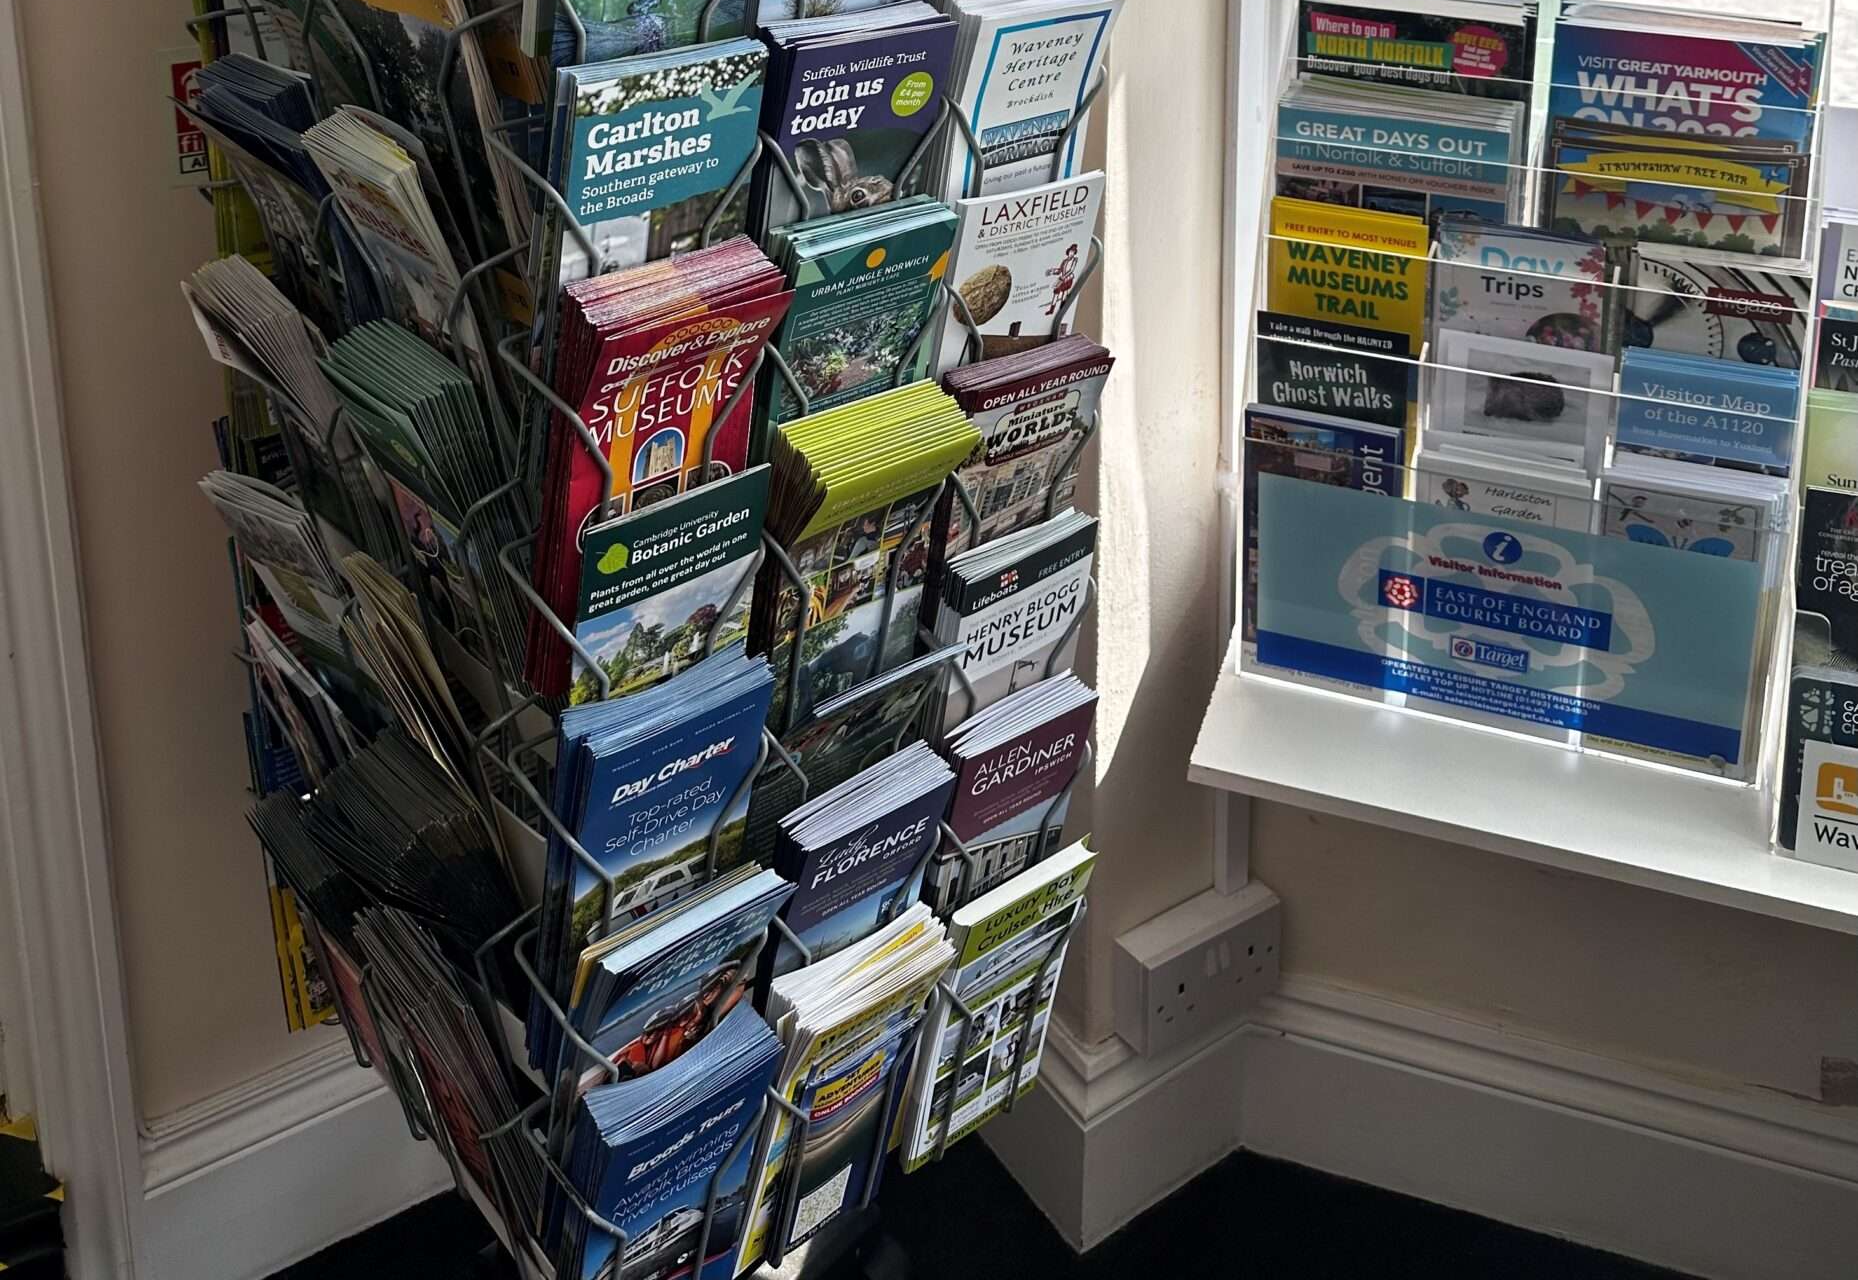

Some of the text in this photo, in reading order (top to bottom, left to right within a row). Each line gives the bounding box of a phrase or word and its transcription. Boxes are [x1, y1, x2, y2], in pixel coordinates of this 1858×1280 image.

[1011, 33, 1084, 55] Waveney
[1315, 17, 1349, 34] Where
[802, 50, 927, 81] Suffolk Wildlife Trust
[1002, 50, 1077, 75] Heritage
[1315, 33, 1368, 58] NORTH
[1372, 39, 1445, 66] NORFOLK
[1008, 71, 1062, 92] Centre
[1578, 55, 1769, 86] VISIT GREAT YARMOUTH
[795, 78, 885, 111] Join us
[1577, 71, 1763, 122] WHAT'S
[587, 108, 700, 150] Carlton
[790, 105, 865, 135] today
[1296, 121, 1487, 157] GREAT DAYS OUT
[584, 132, 712, 180] Marshes
[581, 161, 704, 200] Southern gateway
[606, 188, 655, 210] Broads
[981, 185, 1089, 226] LAXFIELD
[990, 205, 1087, 237] DISTRICT MUSEUM
[1307, 226, 1417, 249] ENTRY VENUES
[811, 255, 930, 298] URBAN JUNGLE NORWICH
[1286, 240, 1412, 276] WAVENEY
[1287, 265, 1409, 301] MUSEUMS
[1481, 275, 1544, 299] Trips
[1314, 292, 1380, 321] TRAIL
[589, 349, 749, 424] SUFFOLK
[983, 364, 1109, 410] OPEN YEAR ROUND
[1289, 359, 1368, 384] Norwich
[589, 372, 741, 447] MUSEUMS
[1008, 402, 1065, 427] Miniature
[1272, 381, 1393, 409] Ghost Walks
[1642, 382, 1771, 415] Visitor Map
[986, 407, 1078, 449] WORLDS
[1703, 415, 1764, 436] A1120
[631, 507, 751, 565] Botanic Garden
[633, 510, 720, 549] Cambridge University
[589, 544, 721, 601] Plants from world
[1428, 555, 1562, 590] Visitor Information
[967, 608, 1024, 645] HENRY
[1027, 577, 1080, 616] BLOGG
[972, 583, 1018, 611] Lifeboats
[1435, 587, 1601, 629] EAST ENGLAND
[962, 594, 1077, 670] MUSEUM
[1434, 601, 1582, 640] TOURIST BOARD
[1477, 644, 1526, 668] Target
[611, 773, 655, 804] Day
[657, 735, 736, 781] Charter
[971, 733, 1075, 796] GARDINER
[974, 740, 1032, 780] ALLEN
[604, 786, 726, 853] Self-Drive Day
[628, 776, 712, 826] Top-rated
[629, 816, 696, 857] Charter
[810, 815, 930, 890] FLORENCE
[985, 870, 1081, 932] Luxury Day
[977, 908, 1039, 951] Cruiser
[627, 1130, 696, 1180] Broads
